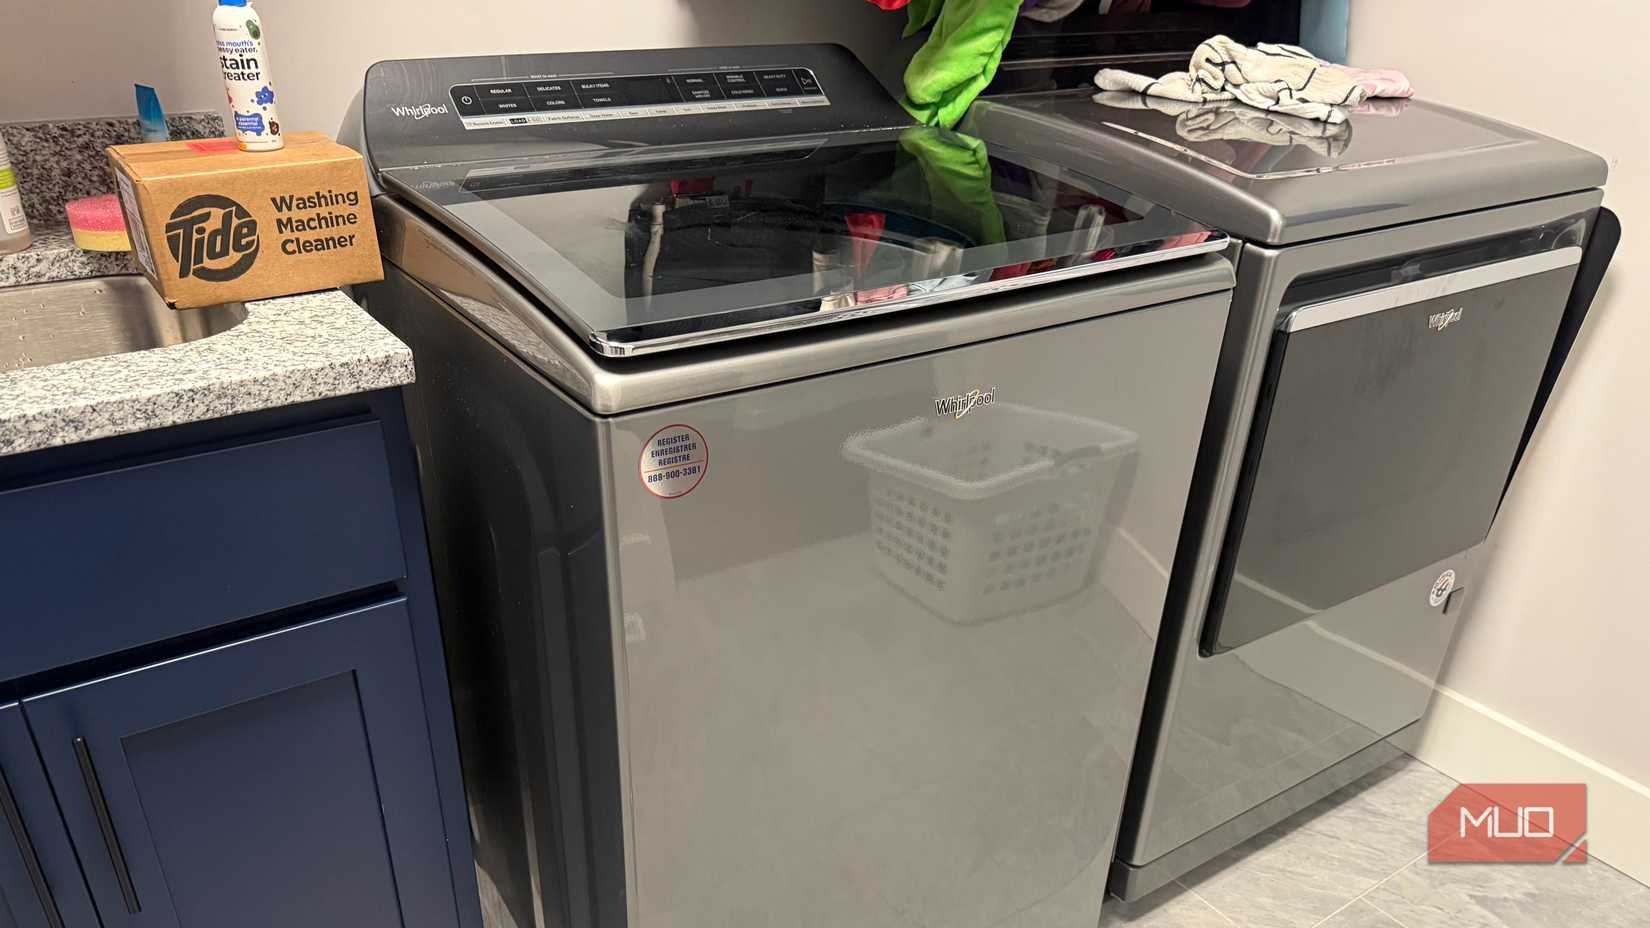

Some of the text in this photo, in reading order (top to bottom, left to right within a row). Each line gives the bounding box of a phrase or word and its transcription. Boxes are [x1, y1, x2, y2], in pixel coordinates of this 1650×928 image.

[224, 71, 261, 81] reater
[391, 104, 449, 120] Whirlpool
[270, 190, 359, 213] Washing
[276, 213, 358, 235] Machine
[165, 207, 258, 279] Tide
[280, 234, 356, 256] Cleaner
[1428, 307, 1463, 331] Whirlpool
[935, 387, 996, 420] Whirlpool
[651, 442, 697, 458] ENREGISTRER
[657, 434, 690, 447] REGISTER
[658, 454, 691, 467] REGISTRE
[647, 465, 701, 483] 888-900-3381
